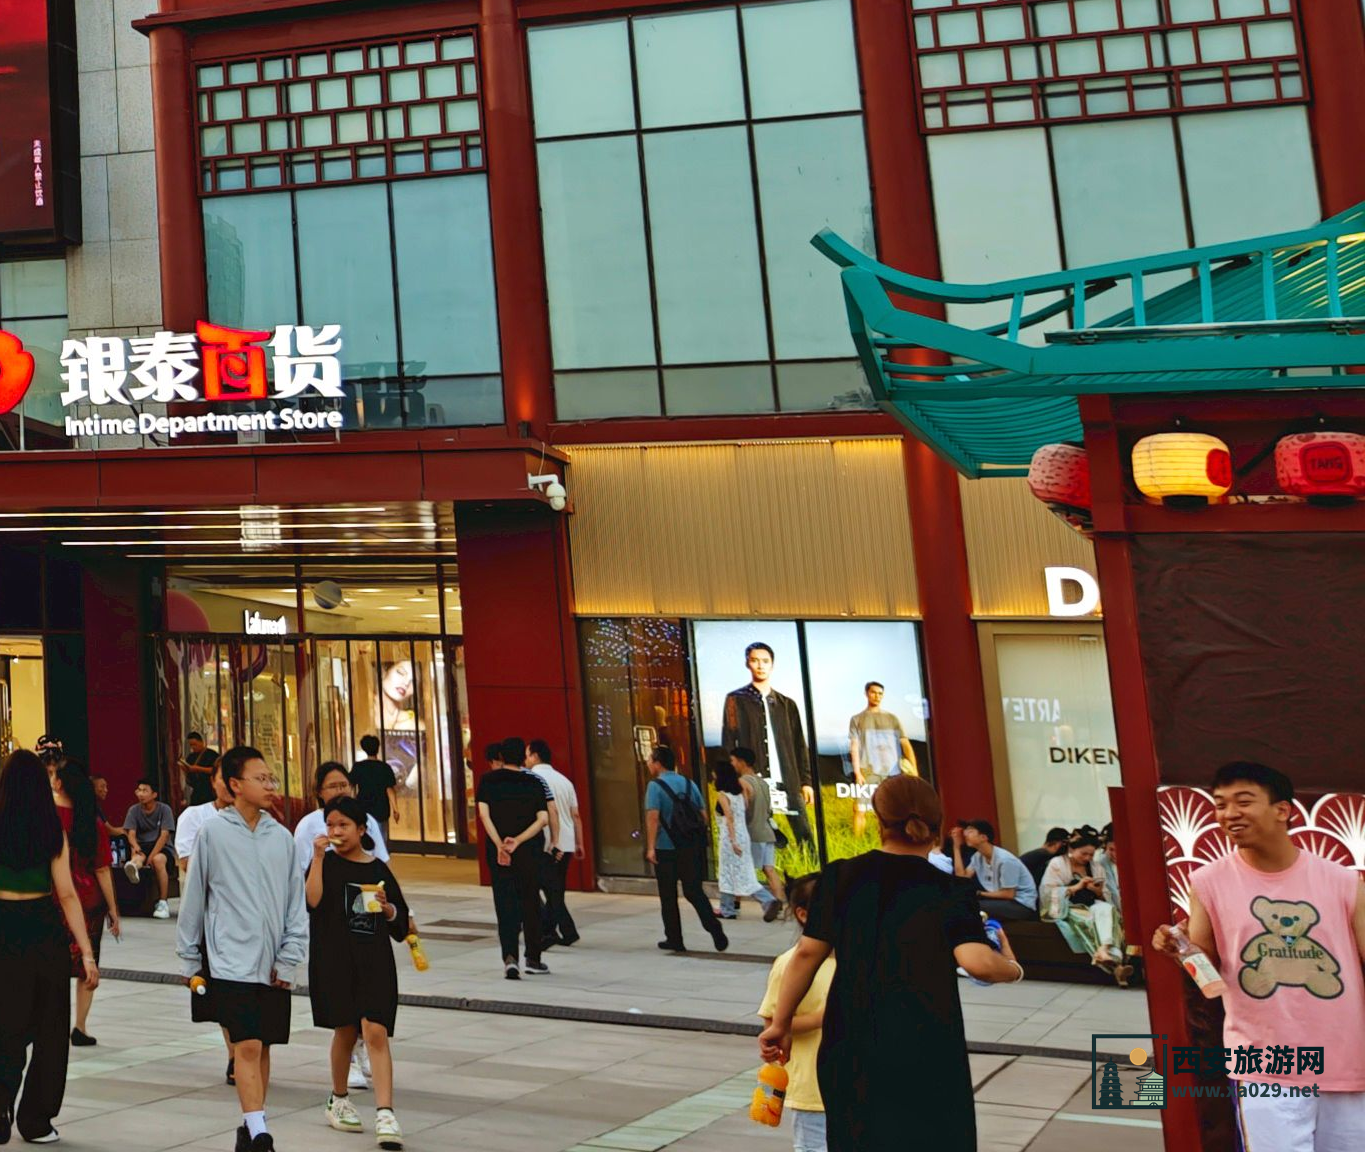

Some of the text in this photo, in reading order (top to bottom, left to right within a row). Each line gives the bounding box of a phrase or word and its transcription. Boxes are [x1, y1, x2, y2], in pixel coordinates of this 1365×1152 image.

[60, 320, 347, 407] 银泰百货
[65, 407, 343, 438] Intime Department Store
[1044, 565, 1101, 617] D
[1257, 942, 1324, 960] Gratitude
